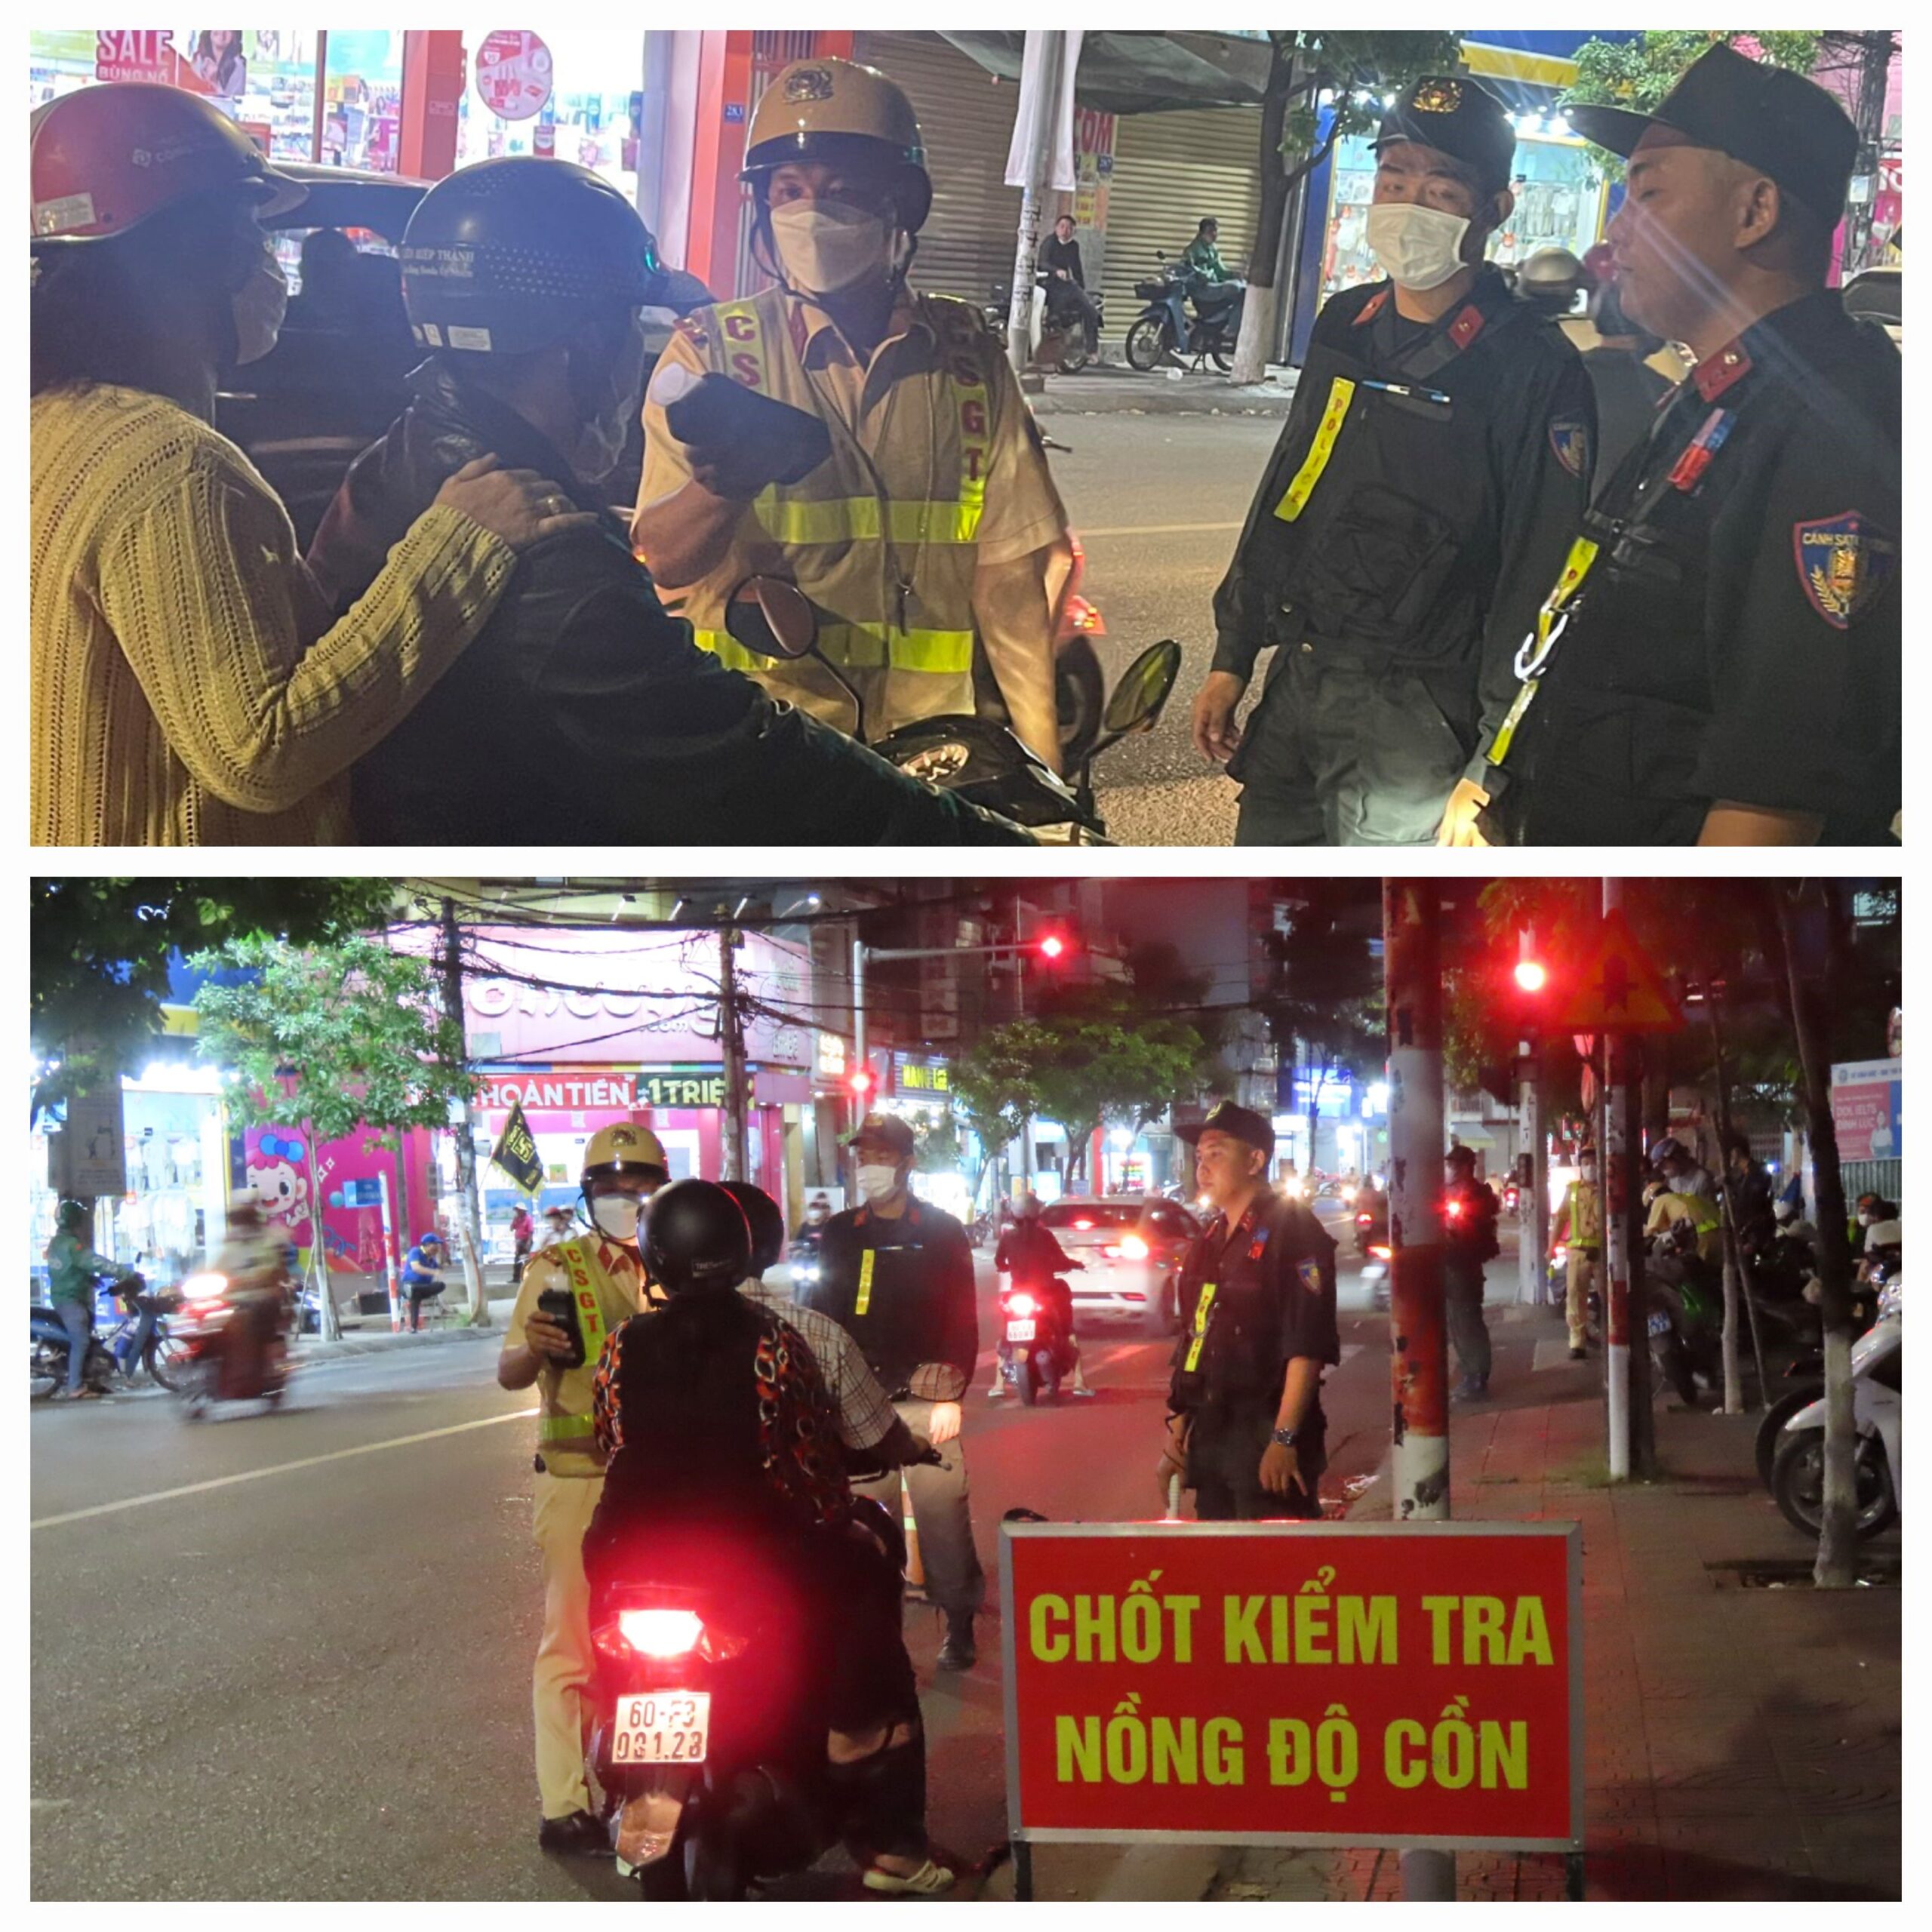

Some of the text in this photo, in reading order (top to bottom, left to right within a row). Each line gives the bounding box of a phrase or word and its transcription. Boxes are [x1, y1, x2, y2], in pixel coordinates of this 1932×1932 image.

[99, 30, 173, 66] SALE
[1291, 398, 1344, 503] POLICE
[481, 1078, 565, 1107] HOÀN
[663, 1077, 727, 1108] TRIỆ
[567, 1248, 598, 1334] CSGT
[1029, 1565, 1554, 1666] CHỐT KIỂM TRA
[1056, 1692, 1527, 1803] NỒNG ĐỘ CỒN
